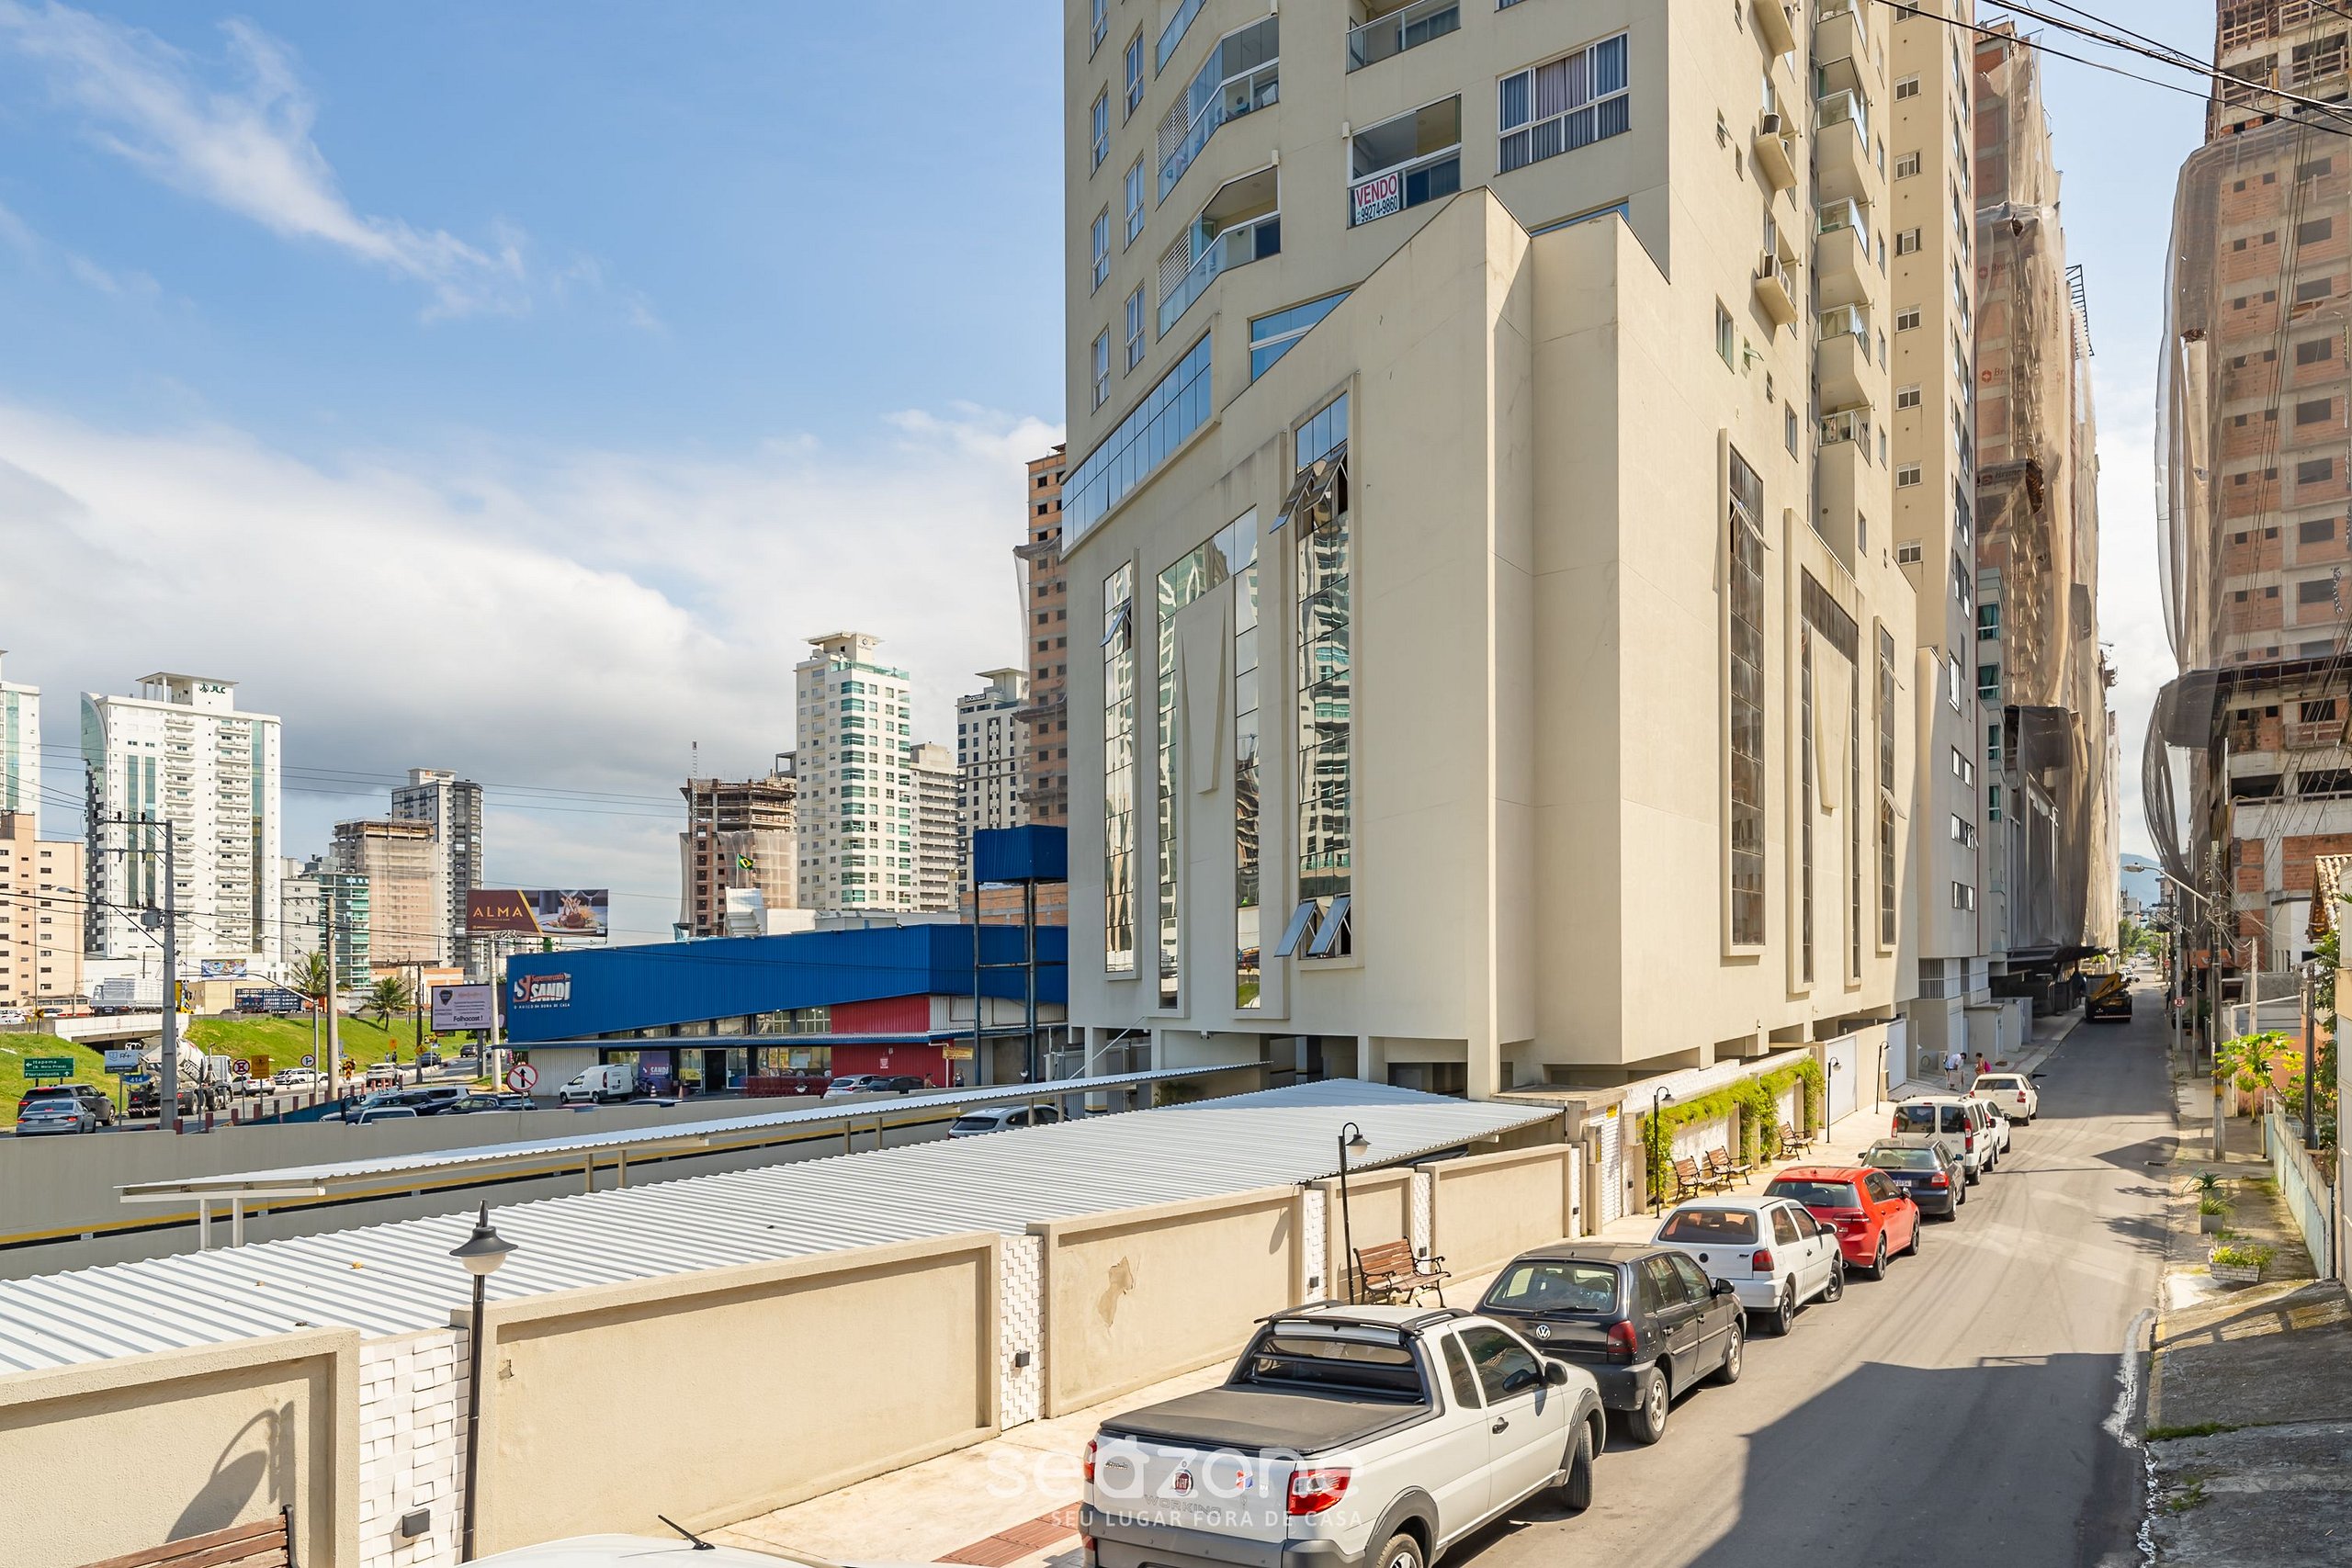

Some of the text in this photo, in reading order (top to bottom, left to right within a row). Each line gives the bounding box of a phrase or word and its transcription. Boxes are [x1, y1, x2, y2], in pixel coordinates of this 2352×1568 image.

[1355, 175, 1397, 208] VENDO
[1361, 195, 1397, 222] 99274-9860
[472, 906, 524, 918] ALMA
[1143, 1494, 1222, 1517] WORKING
